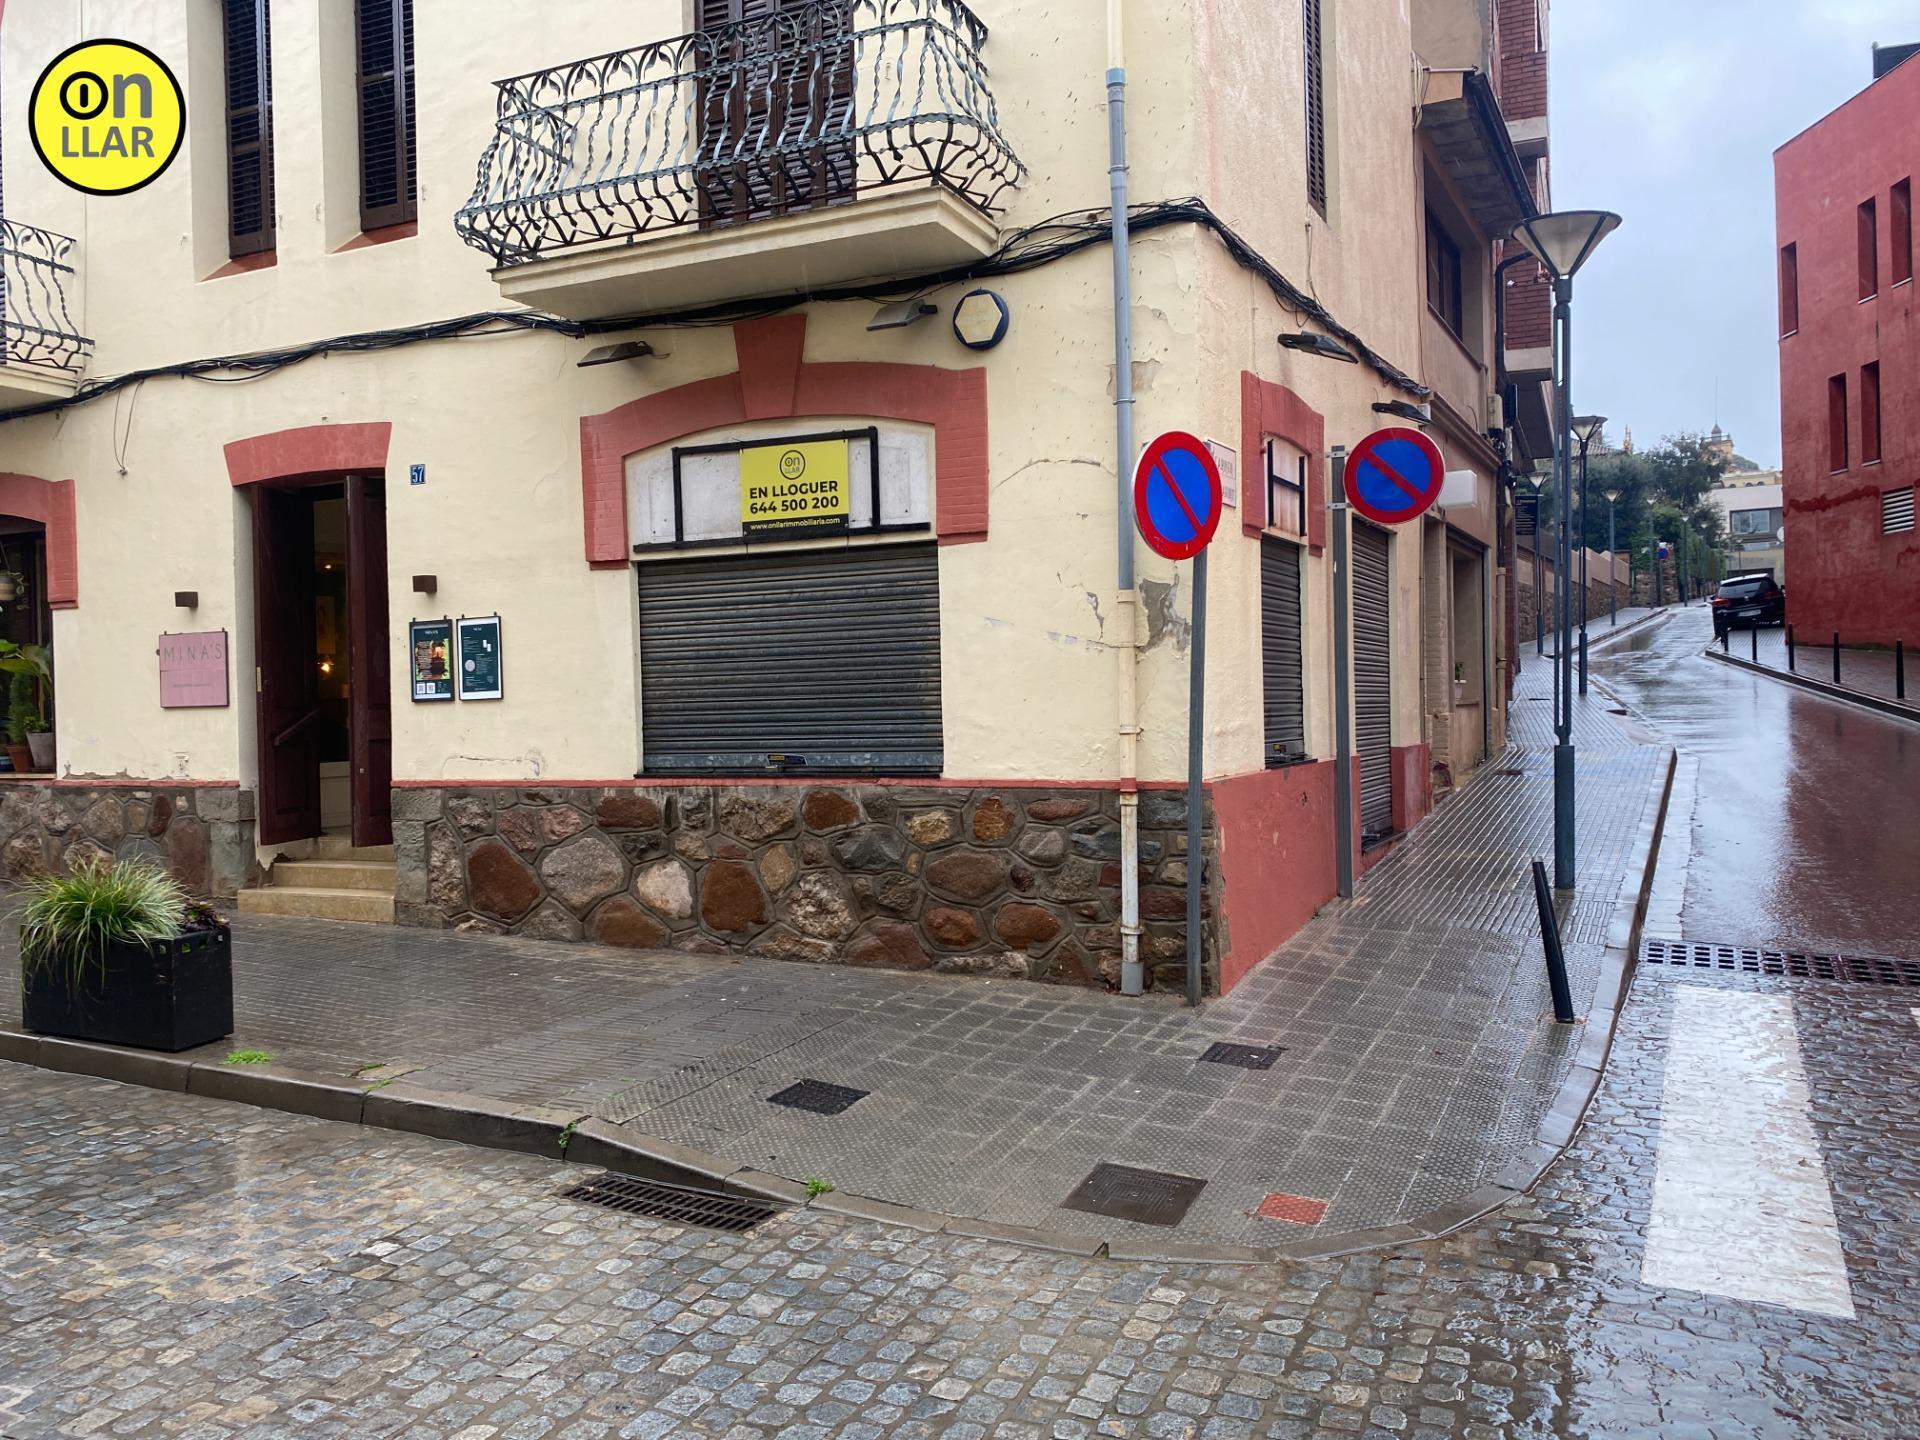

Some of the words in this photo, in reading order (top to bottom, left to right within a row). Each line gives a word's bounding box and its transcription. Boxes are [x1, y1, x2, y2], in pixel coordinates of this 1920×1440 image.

[412, 466, 424, 482] 57
[784, 466, 801, 474] LLAR
[749, 486, 768, 499] EN
[772, 480, 838, 497] LLOGUER
[750, 501, 777, 514] 644
[781, 499, 808, 511] 500
[812, 495, 839, 509] 200
[164, 643, 222, 661] MINA'S
